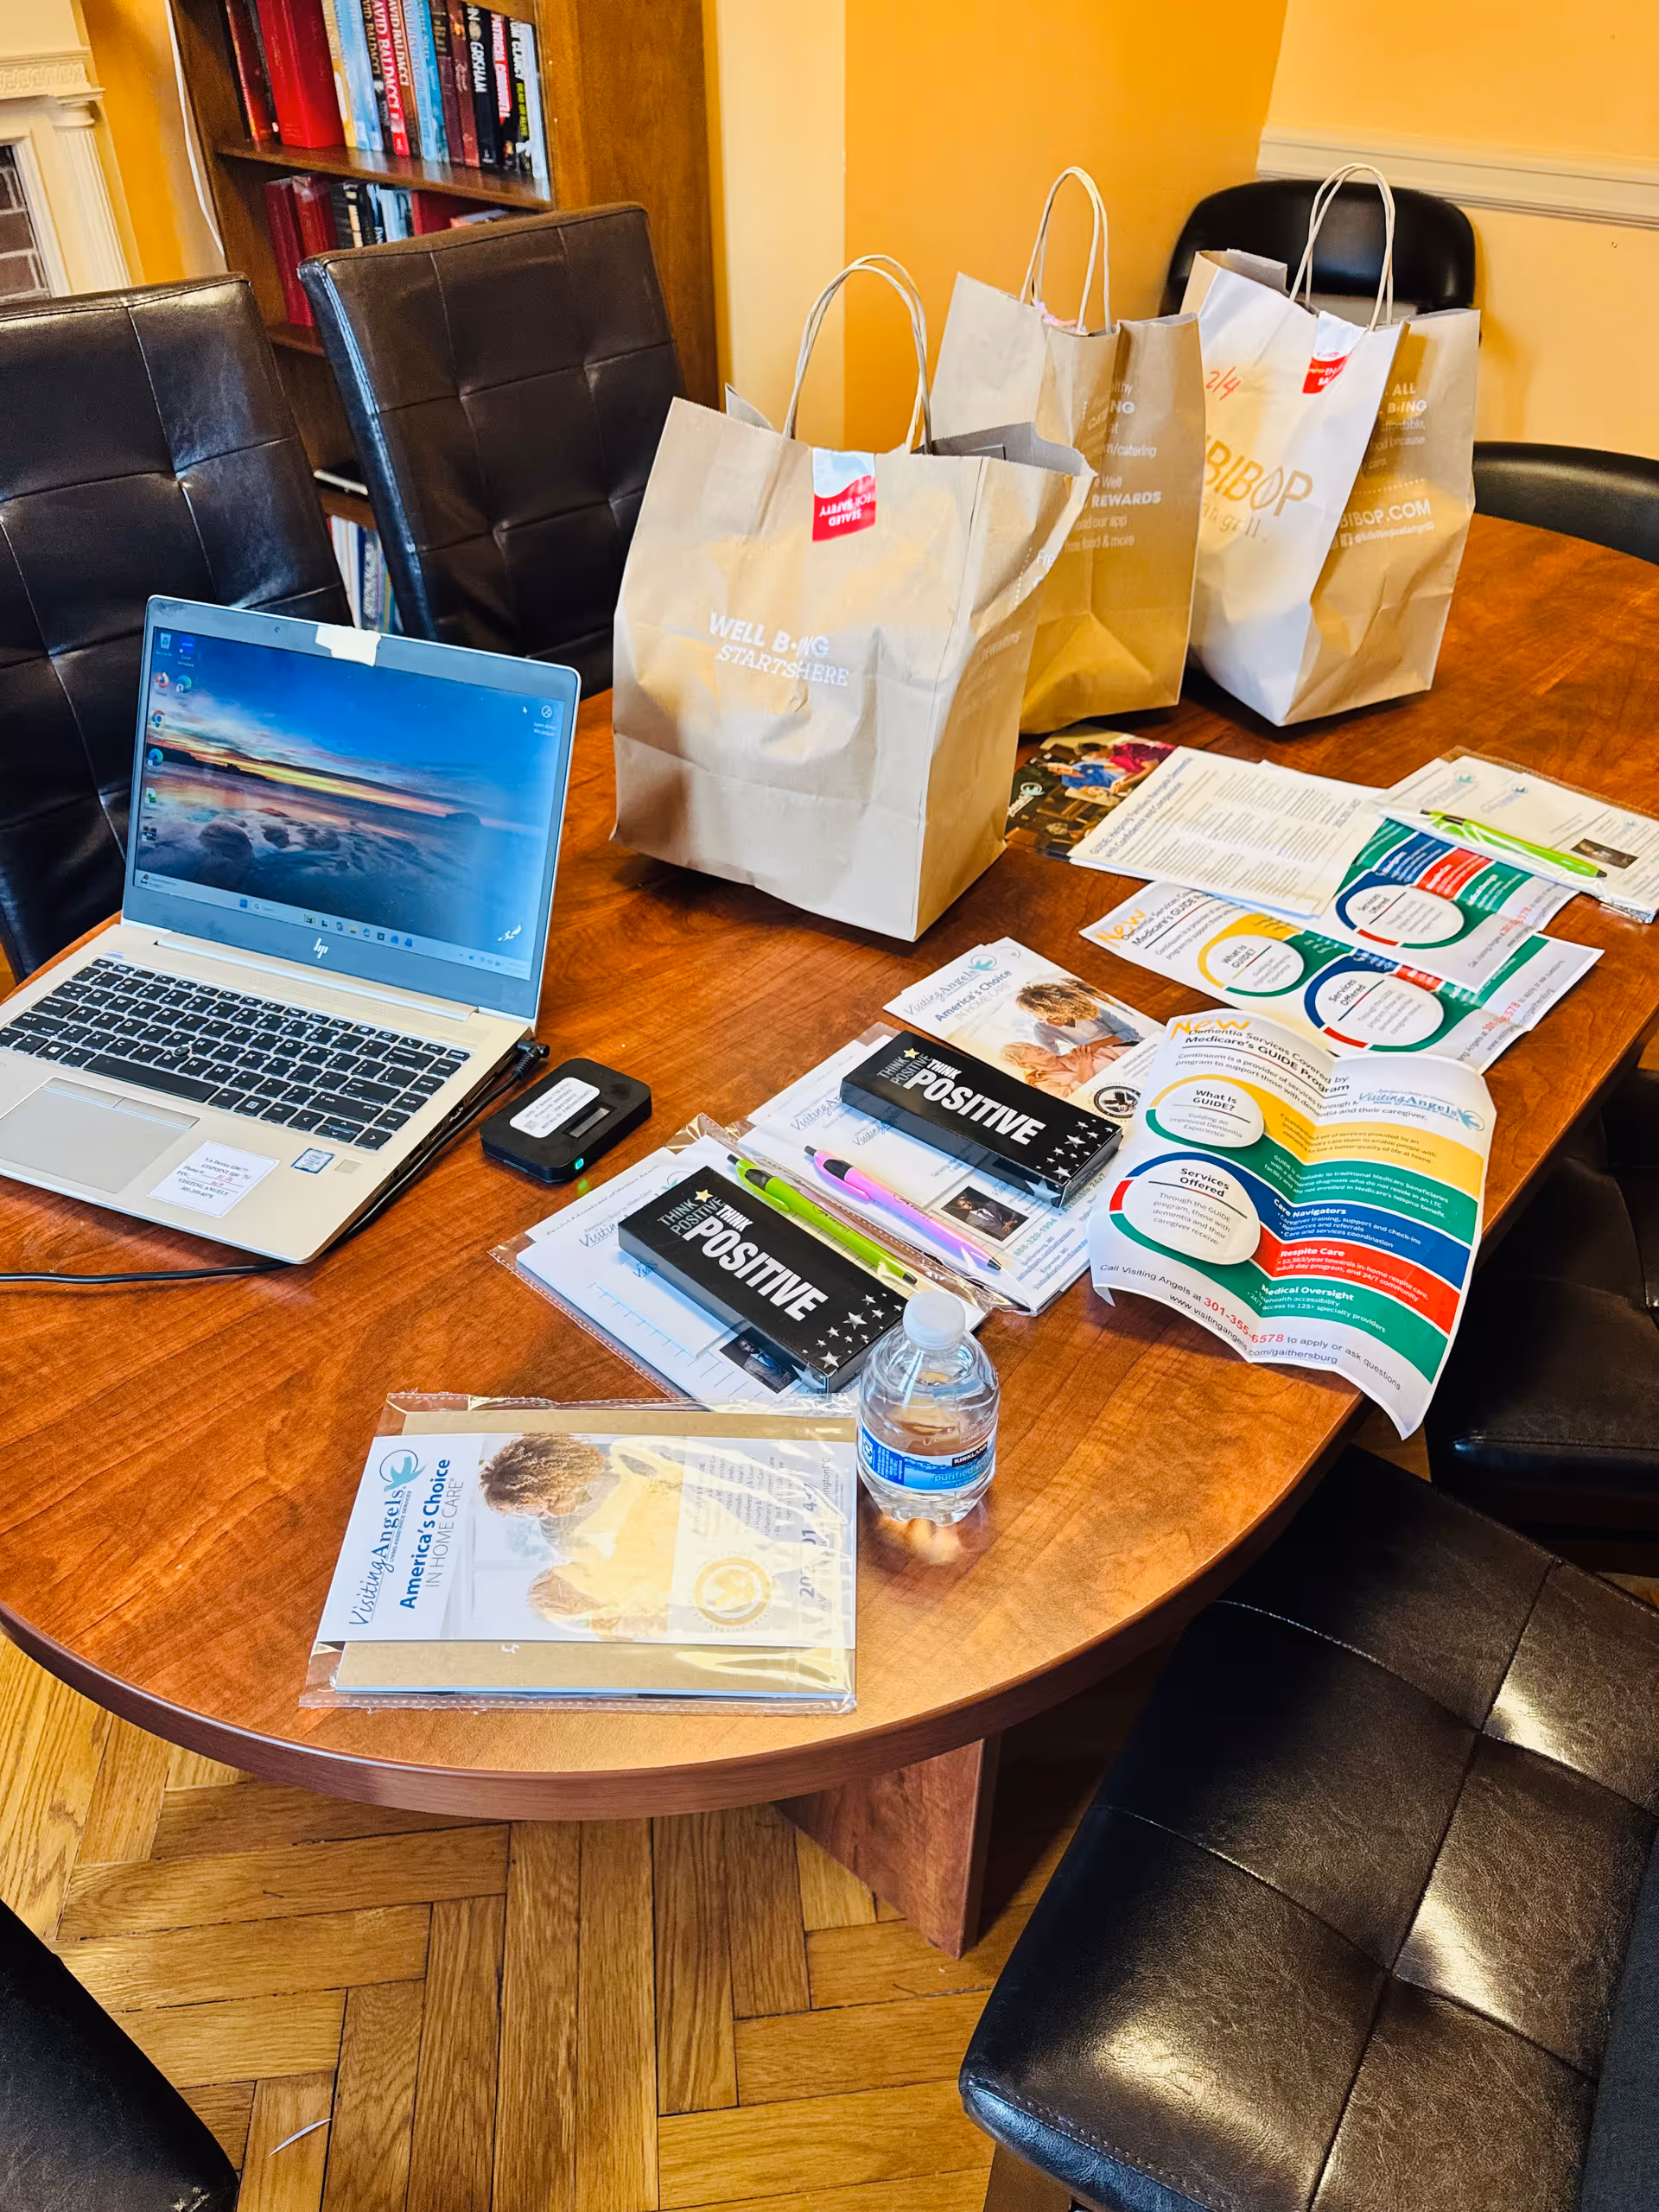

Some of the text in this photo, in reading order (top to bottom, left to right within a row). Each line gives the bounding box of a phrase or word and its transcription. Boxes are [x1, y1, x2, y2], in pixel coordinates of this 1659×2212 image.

[389, 0, 410, 86] AVID BALDACCI
[491, 14, 505, 60] PATRICIA
[372, 0, 399, 109] AVID BALDACCI
[470, 41, 487, 92] GRISHAM
[819, 493, 871, 517] FOR SAFETY
[1092, 491, 1161, 508] REWARDS
[829, 509, 861, 526] SEALED
[709, 611, 766, 646] WELL
[716, 644, 849, 687] STARTS HERE
[1151, 895, 1179, 918] Services
[1132, 898, 1197, 945] Medicare's GUIDE
[934, 969, 1013, 1022] America's Choice
[1328, 979, 1357, 1003] Services
[1340, 983, 1367, 1006] Offered
[1170, 1019, 1250, 1040] New
[876, 1056, 906, 1080] THINK
[1185, 1037, 1350, 1094] Medicare's GUIDE Program
[1188, 1028, 1243, 1038] Dementia
[1246, 1033, 1290, 1056] Services
[1293, 1053, 1332, 1084] Covered
[926, 1059, 963, 1080] THINK
[1178, 1053, 1352, 1110] Continuum provider services through
[1195, 1089, 1237, 1104] What Is
[1225, 1063, 1260, 1077] support
[1261, 1075, 1283, 1089] those
[1284, 1088, 1300, 1101] with
[1300, 1099, 1338, 1117] dementia
[904, 1068, 1046, 1146] POSITIVE
[1192, 1096, 1236, 1111] GUIDE?
[1169, 1117, 1243, 1138] Improved Dementia
[1188, 1112, 1217, 1124] Guiding
[1183, 1124, 1225, 1138] Experience
[1179, 1177, 1225, 1198] Offered
[1180, 1168, 1230, 1190] Services
[1372, 1173, 1404, 1186] Medicare
[1405, 1182, 1448, 1204] beneficiaries
[1160, 1192, 1231, 1223] Through the GUIDE
[1274, 1198, 1346, 1218] Care Navigators
[1355, 1185, 1391, 1198] Medicare's
[1392, 1193, 1420, 1208] hospice
[1389, 1186, 1411, 1197] reside
[1430, 1200, 1442, 1209] LTC
[657, 1198, 699, 1227] THINK
[715, 1205, 754, 1233] THINK
[1153, 1209, 1226, 1239] dementia and their
[1154, 1201, 1230, 1232] program, those with
[1154, 1217, 1191, 1232] caregiver
[1280, 1214, 1310, 1225] Caregiver
[1342, 1217, 1372, 1227] support
[1373, 1224, 1388, 1232] and
[1388, 1229, 1422, 1245] check-ins
[1334, 1224, 1365, 1232] referrals
[1347, 1230, 1394, 1248] coordination
[1280, 1248, 1346, 1257] Respite Care
[682, 1216, 830, 1322] POSITIVE
[1357, 1262, 1389, 1278] in-home
[1389, 1274, 1412, 1288] respite
[1261, 1284, 1355, 1301] Medical Oversight
[1362, 1273, 1419, 1302] 24/7 community
[1294, 1297, 1340, 1306] accessibility
[1122, 1267, 1157, 1281] Visiting
[1158, 1276, 1191, 1295] Angels
[1192, 1294, 1202, 1302] at
[1204, 1297, 1285, 1344] 301-355-6578
[1300, 1338, 1329, 1350] apply
[1344, 1347, 1362, 1362] ask
[1363, 1358, 1402, 1391] questions
[1316, 1306, 1386, 1332] specialty providers
[954, 1443, 988, 1465] KIRKLAND
[398, 1457, 451, 1610] America's Choice
[429, 1519, 454, 1569] HOME
[425, 1570, 442, 1589] IN
